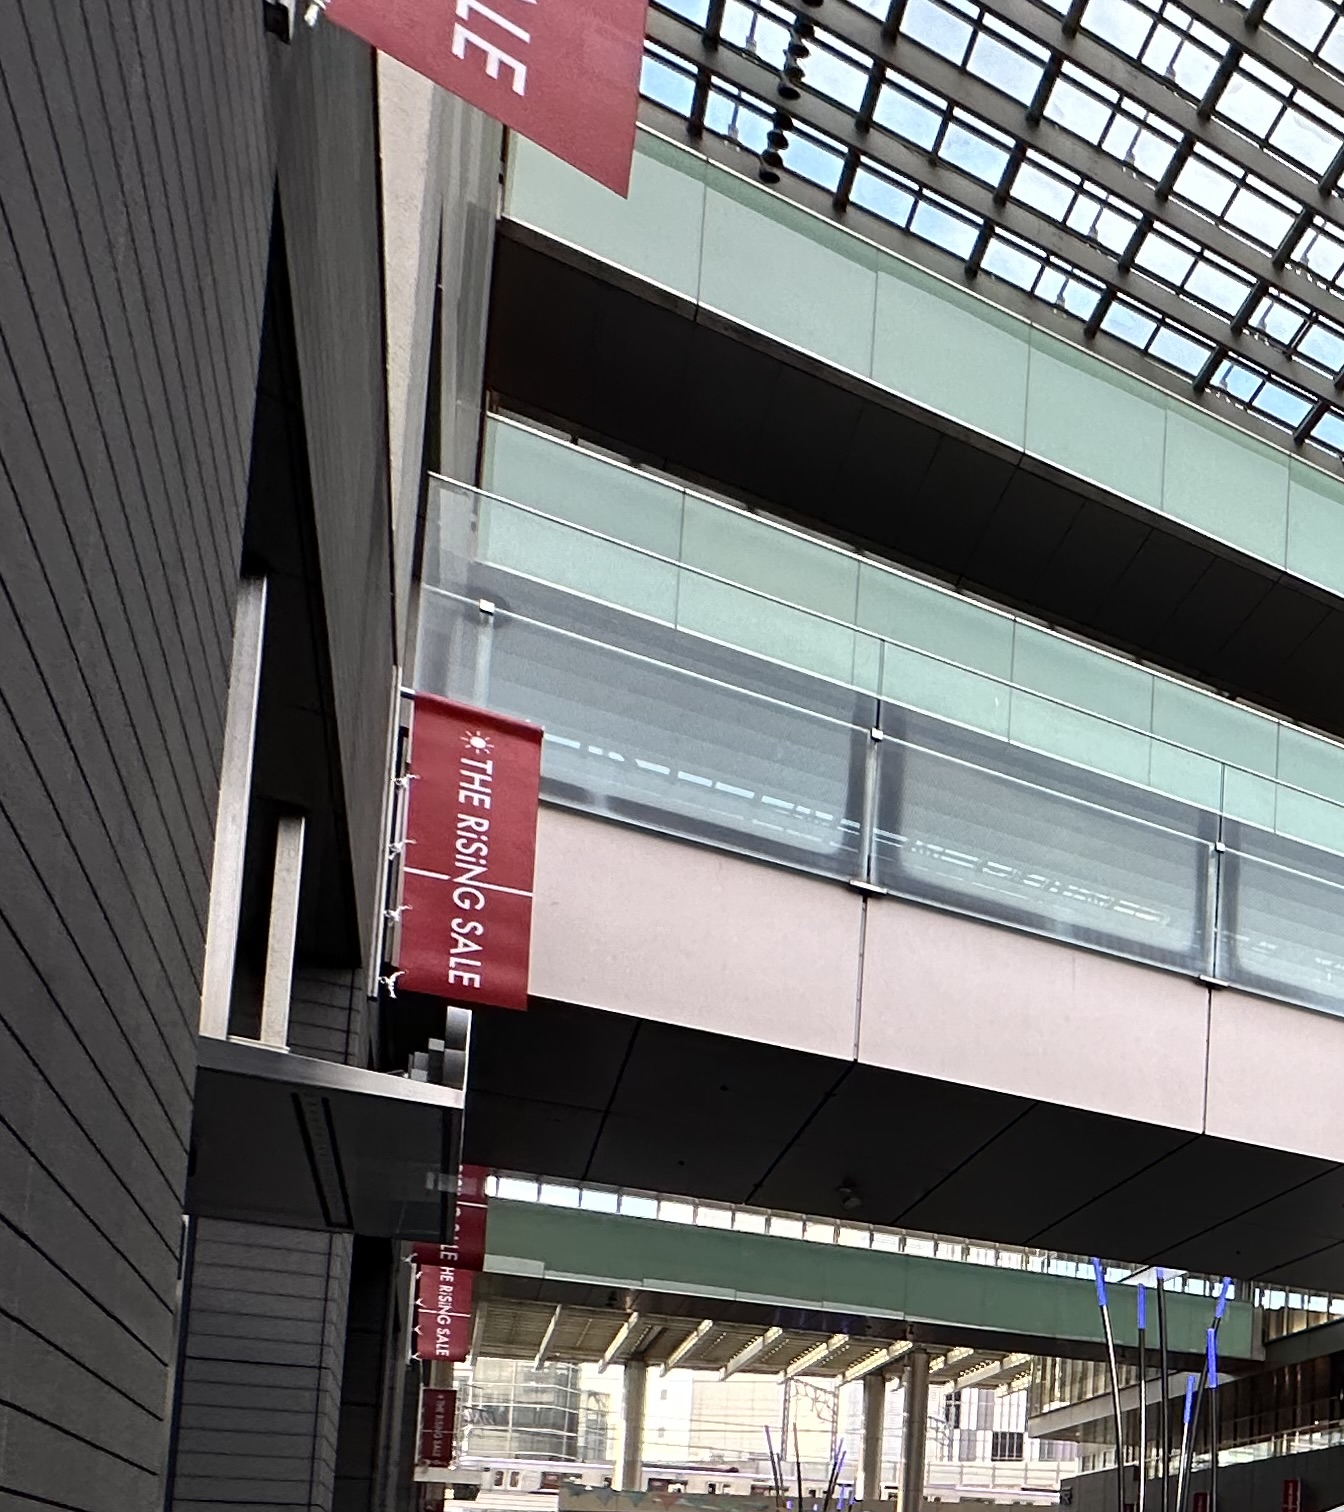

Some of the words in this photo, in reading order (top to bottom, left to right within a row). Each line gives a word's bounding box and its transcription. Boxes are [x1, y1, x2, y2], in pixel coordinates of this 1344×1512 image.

[458, 757, 493, 810] THE
[448, 917, 484, 990] SALE
[436, 1327, 451, 1357] SALE
